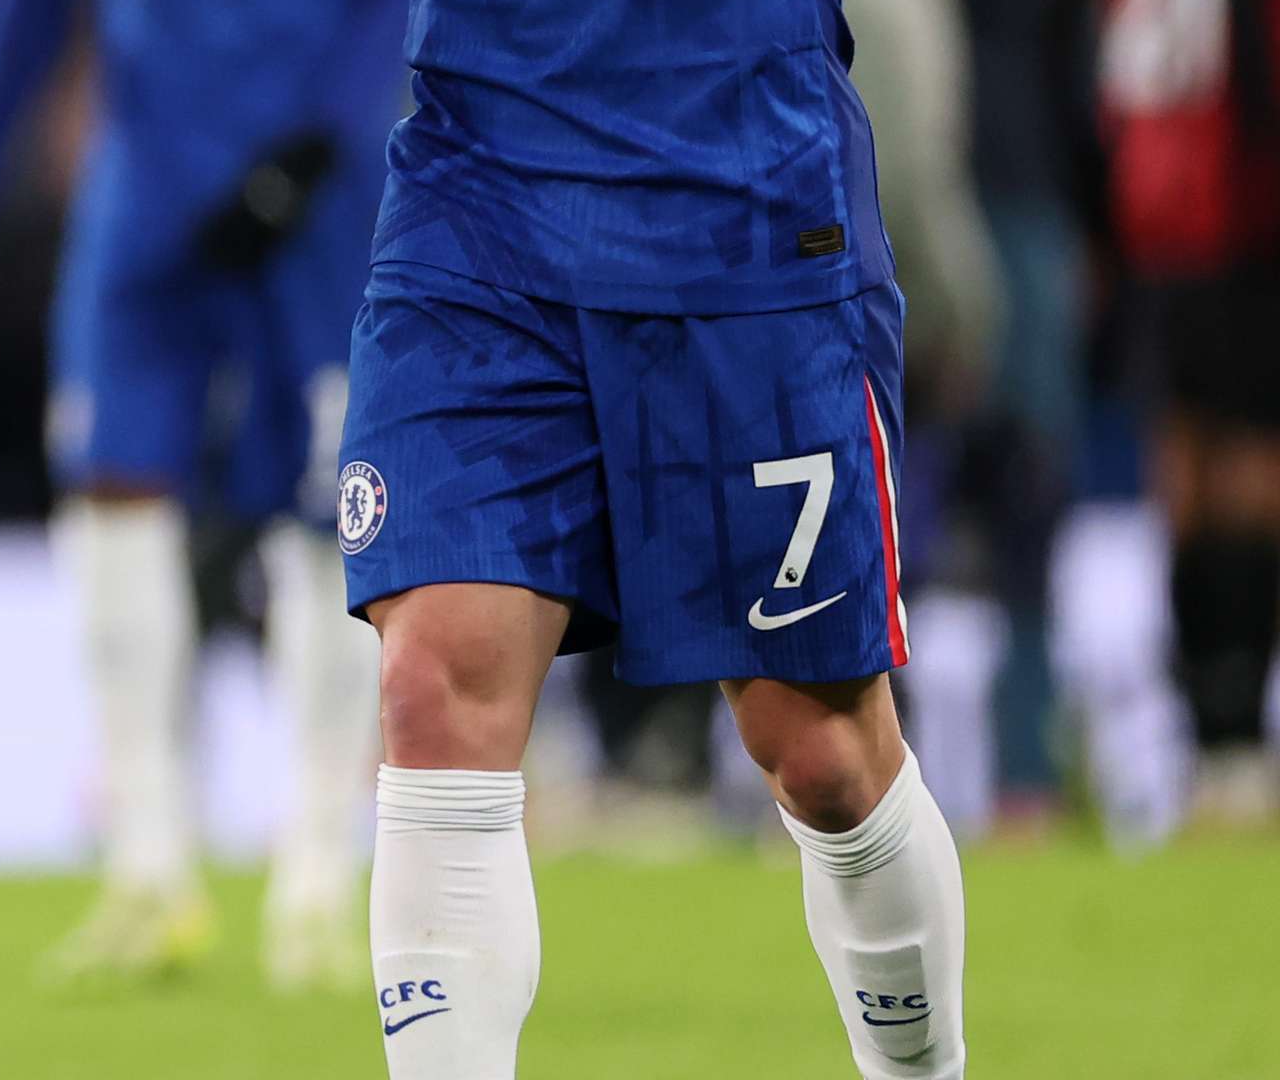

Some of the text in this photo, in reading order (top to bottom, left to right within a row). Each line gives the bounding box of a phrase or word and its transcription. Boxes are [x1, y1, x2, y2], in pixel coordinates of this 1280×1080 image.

[753, 451, 835, 588] 7
[380, 979, 447, 1009] CFC
[856, 990, 929, 1010] CFC
